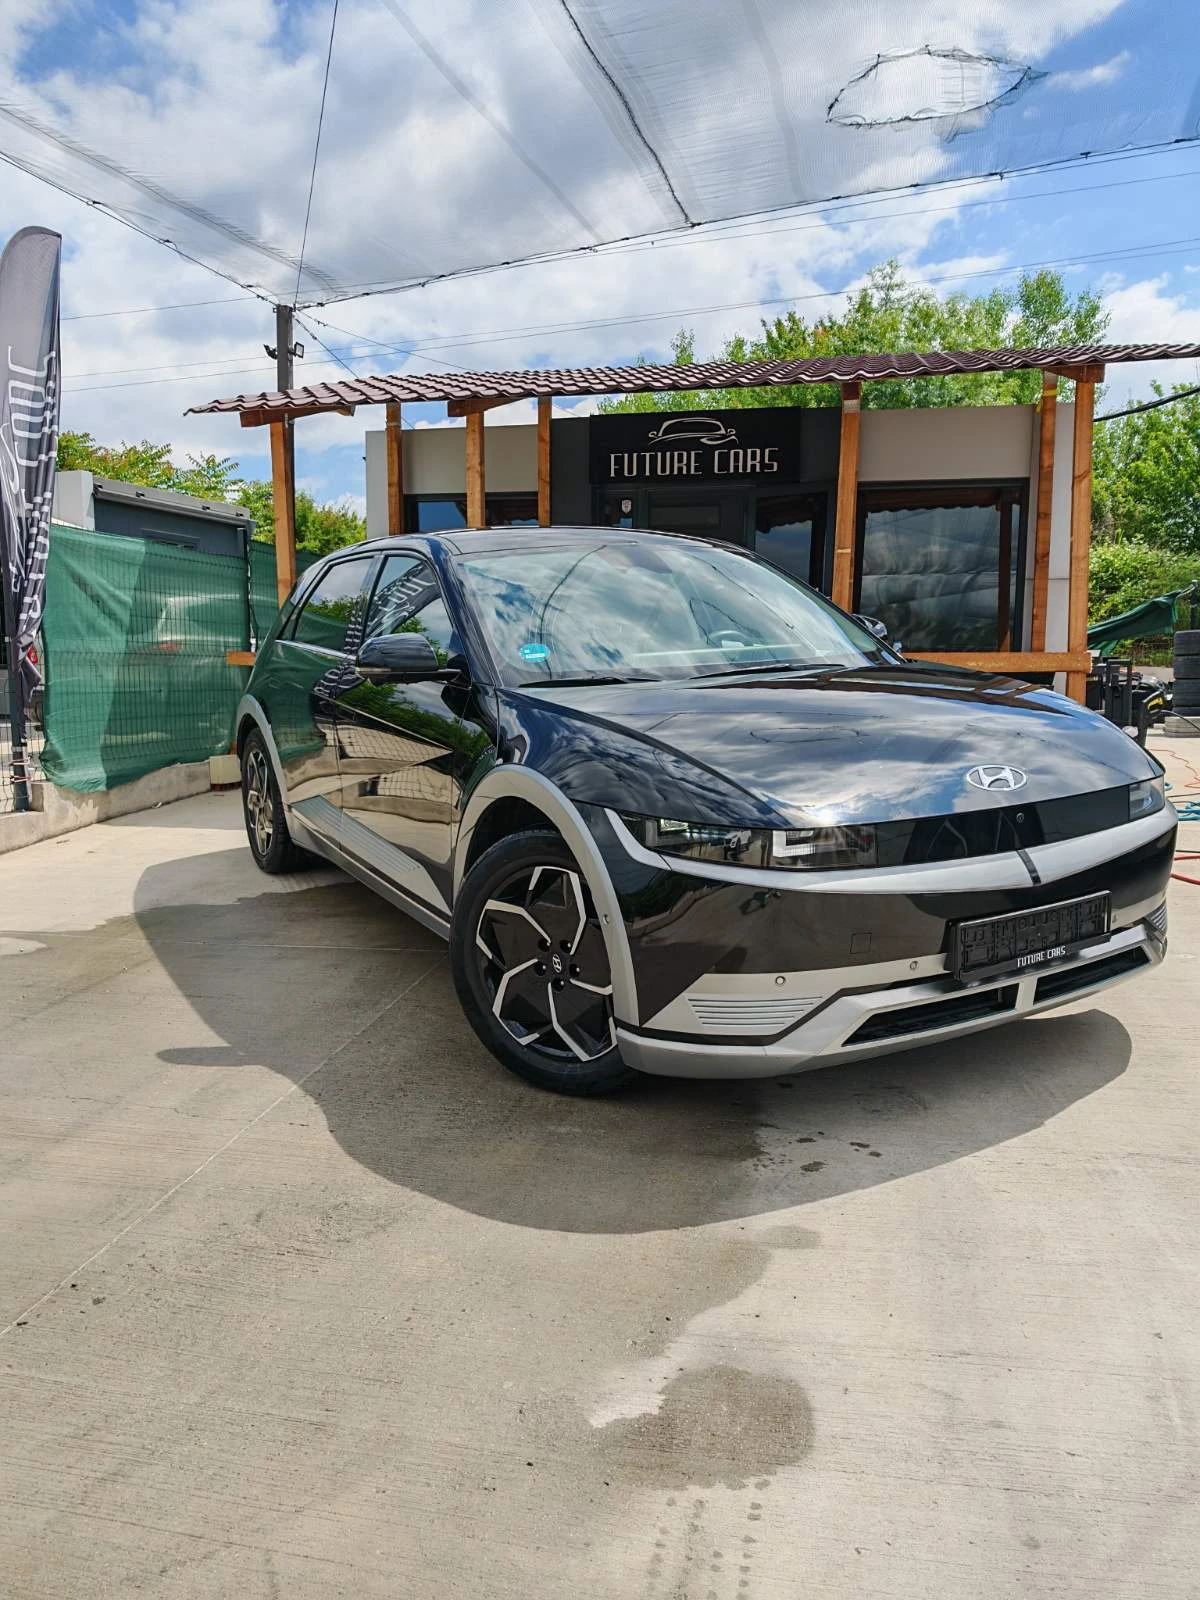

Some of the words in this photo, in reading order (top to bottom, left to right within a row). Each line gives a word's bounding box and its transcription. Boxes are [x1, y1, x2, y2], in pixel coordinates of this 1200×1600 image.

[609, 450, 703, 478] FUTURE
[714, 447, 779, 474] CARS
[1017, 951, 1045, 968] FUTURE
[1047, 945, 1066, 959] CARS
